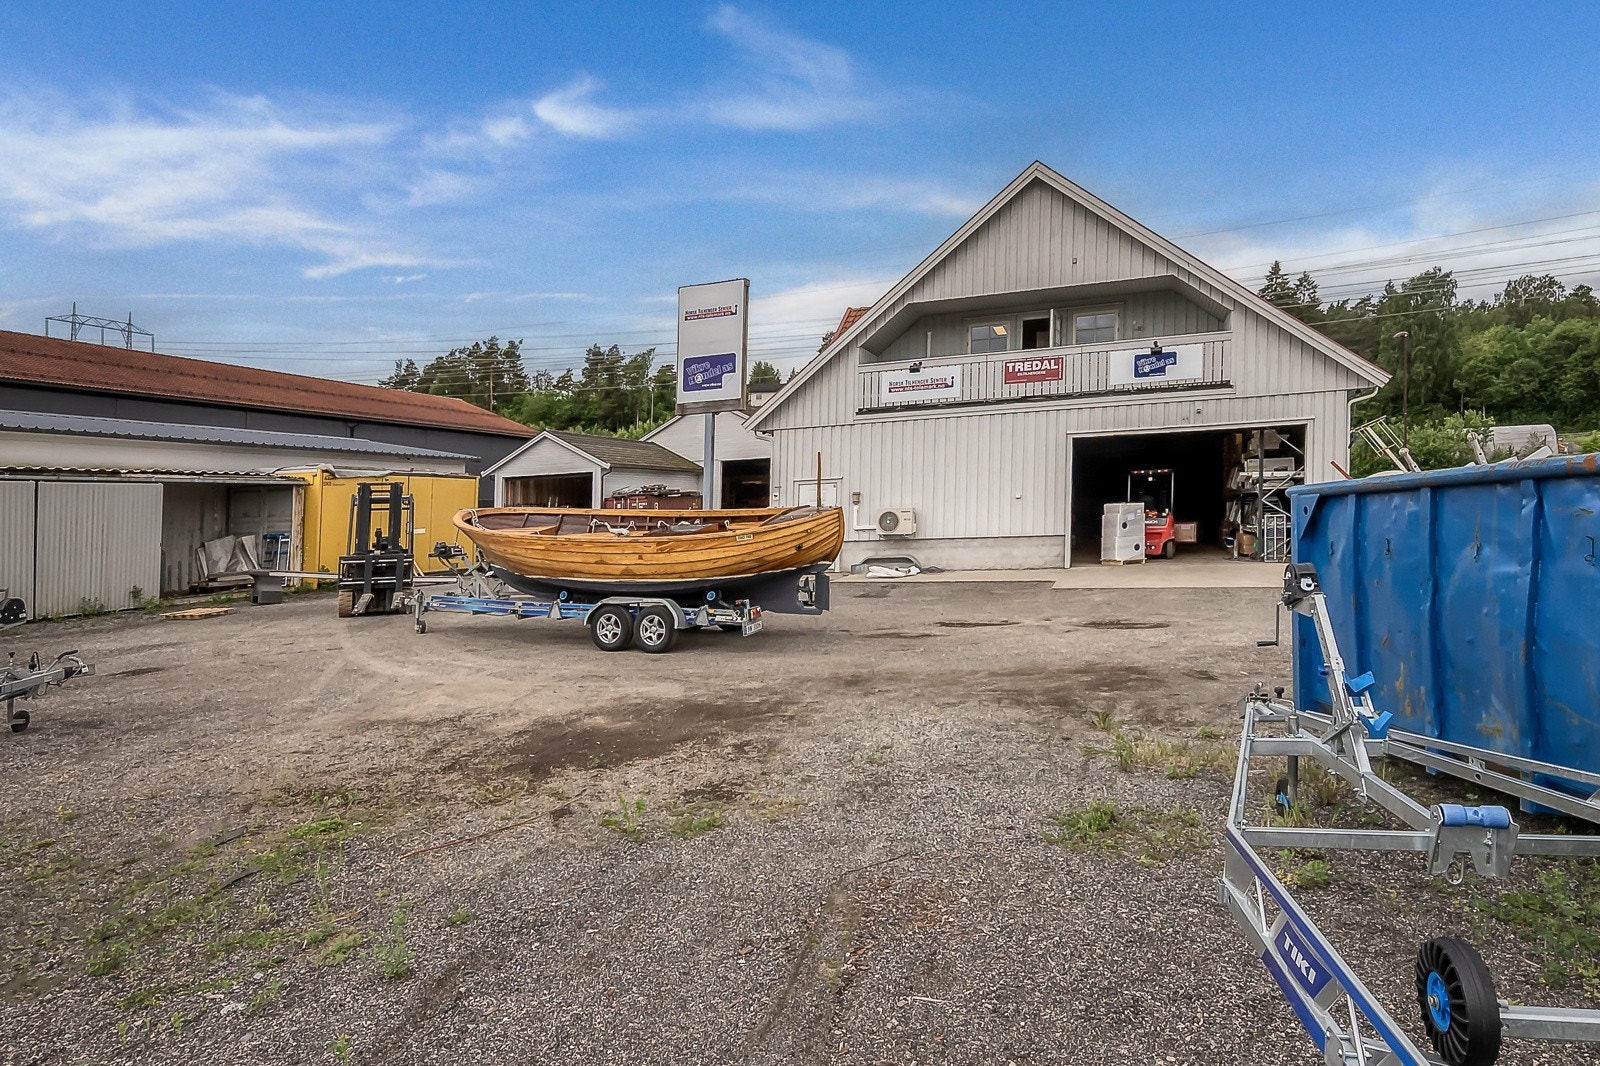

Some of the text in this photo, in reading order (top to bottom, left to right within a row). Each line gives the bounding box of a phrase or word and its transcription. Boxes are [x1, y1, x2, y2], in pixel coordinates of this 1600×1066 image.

[686, 361, 711, 375] Vikre
[1006, 360, 1058, 372] TREDAL
[1283, 931, 1317, 985] TIKI
